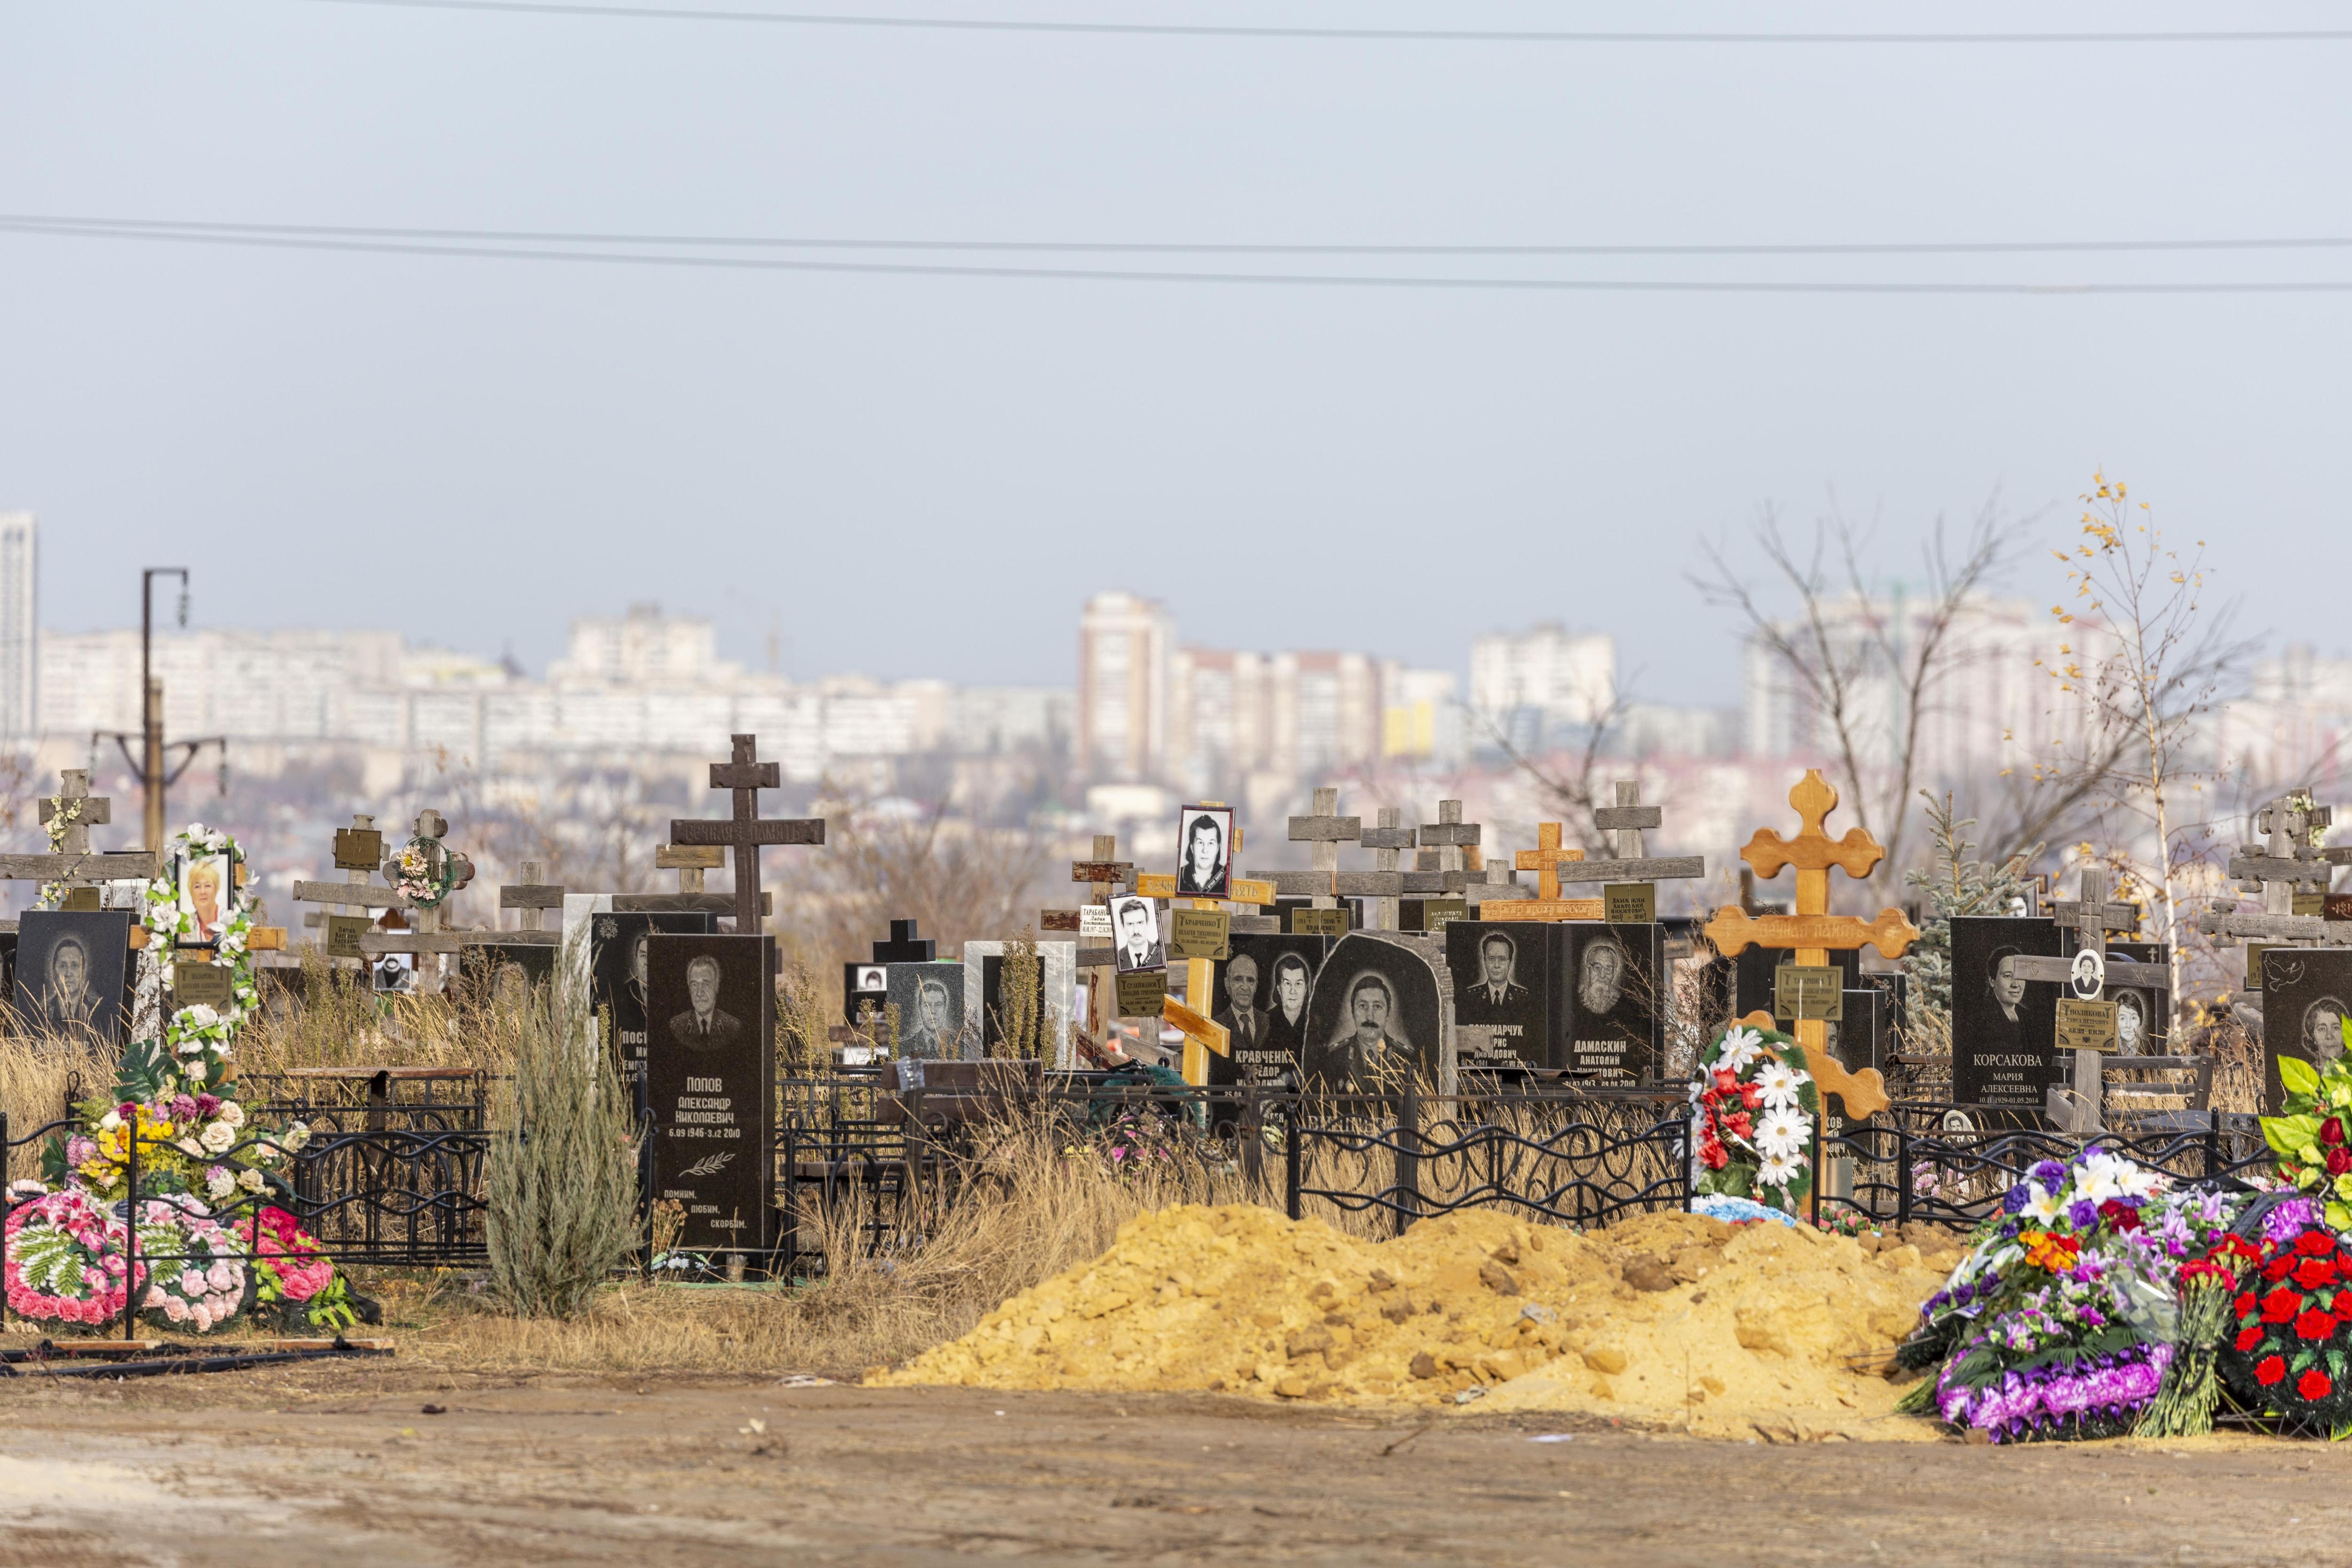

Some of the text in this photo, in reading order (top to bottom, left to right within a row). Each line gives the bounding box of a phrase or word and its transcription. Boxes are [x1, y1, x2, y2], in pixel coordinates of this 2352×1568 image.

[1231, 883, 1258, 897] МЯТЬ
[1469, 1024, 1523, 1036] МАРЧУК
[622, 1031, 647, 1044] ПОСТ
[1494, 1038, 1507, 1047] РИС
[1574, 1040, 1626, 1052] ДАМАСКИН
[1580, 1054, 1620, 1065] АНАТОЛИЙ
[1974, 1054, 2042, 1066] КОРСАКОВА
[1577, 1067, 1623, 1077] ТОВИЧ
[687, 1077, 722, 1092] ПОПОВ
[1981, 1085, 2038, 1093] АЛЕКСЕЕВНА
[678, 1097, 731, 1110] АЛЕКСАНДР
[675, 1111, 734, 1124] НИКОЛАЕВИЧ
[723, 1128, 740, 1138] 2010
[664, 1190, 697, 1199] ПОМНИМ,
[710, 1219, 747, 1229] СКОРБИМ.
